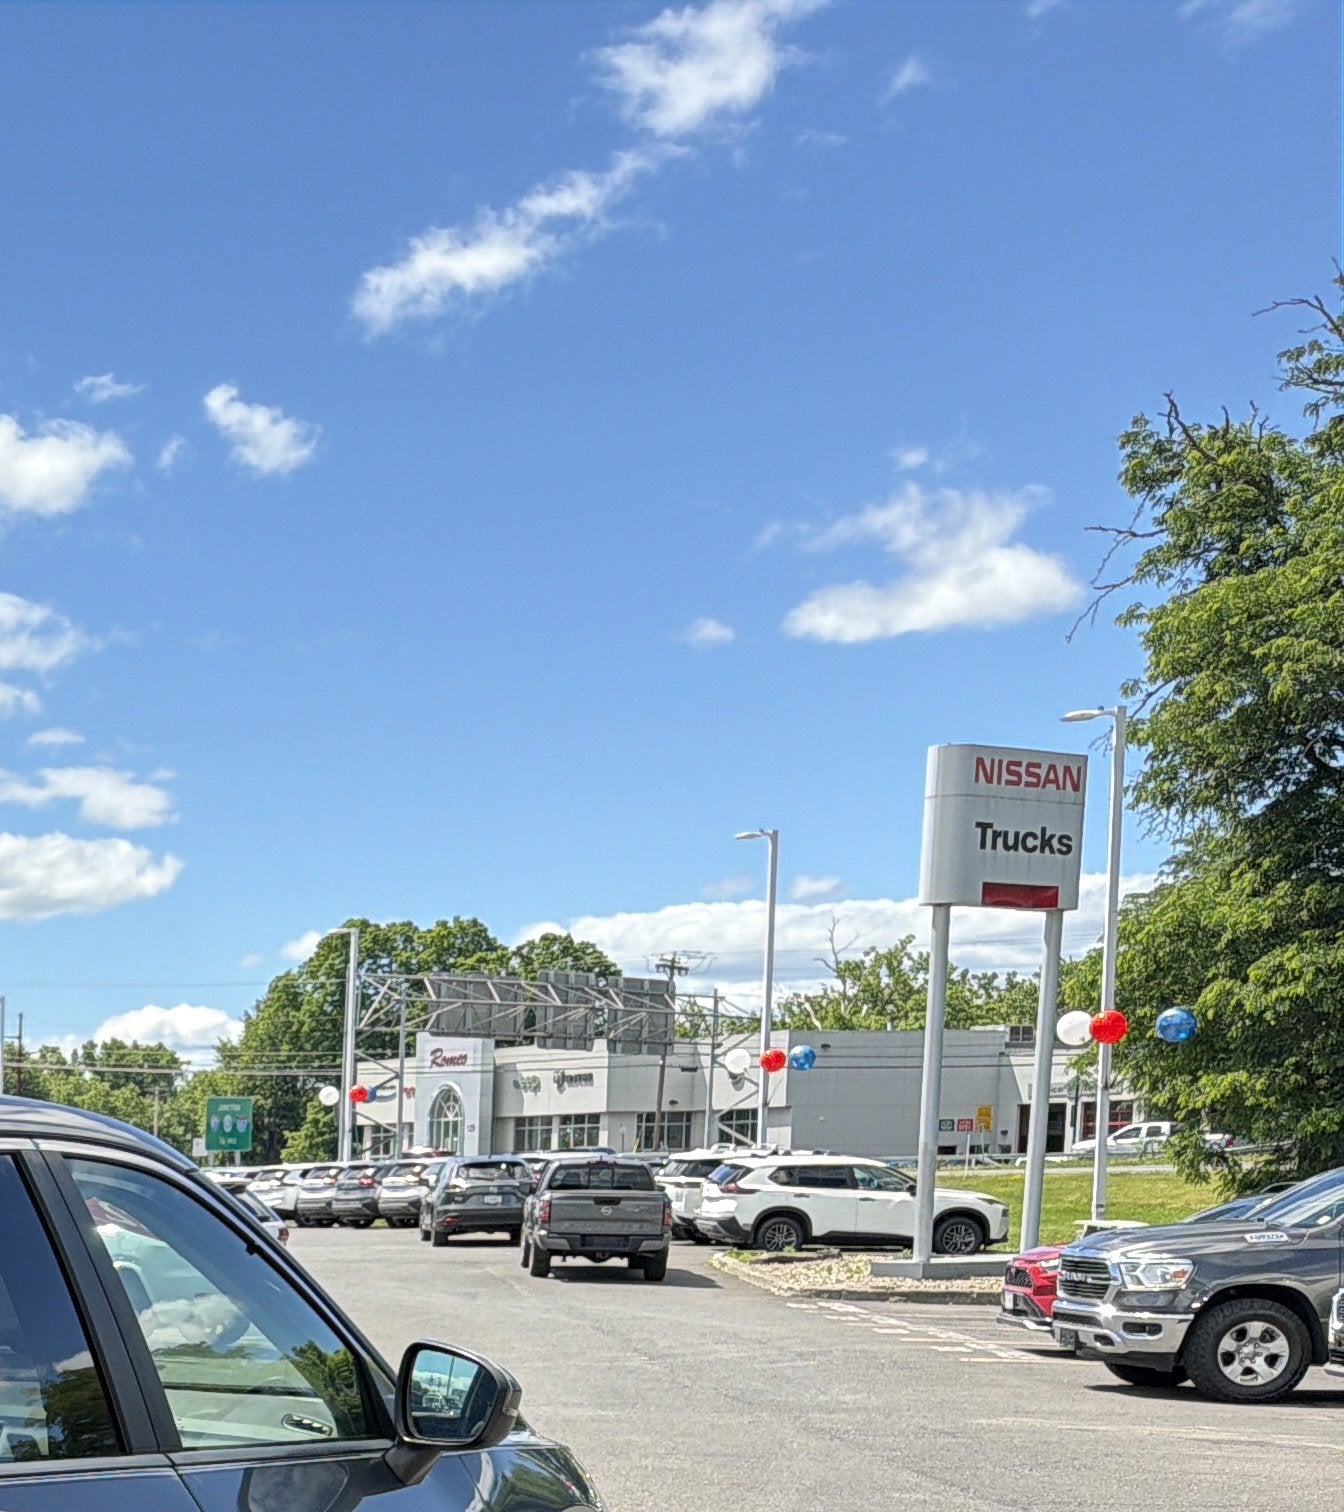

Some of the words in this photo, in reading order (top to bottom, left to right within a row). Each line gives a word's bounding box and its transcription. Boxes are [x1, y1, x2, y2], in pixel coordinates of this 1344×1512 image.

[974, 757, 1082, 793] NISSAN
[975, 821, 1073, 856] Trucks
[429, 1047, 468, 1069] Romeo
